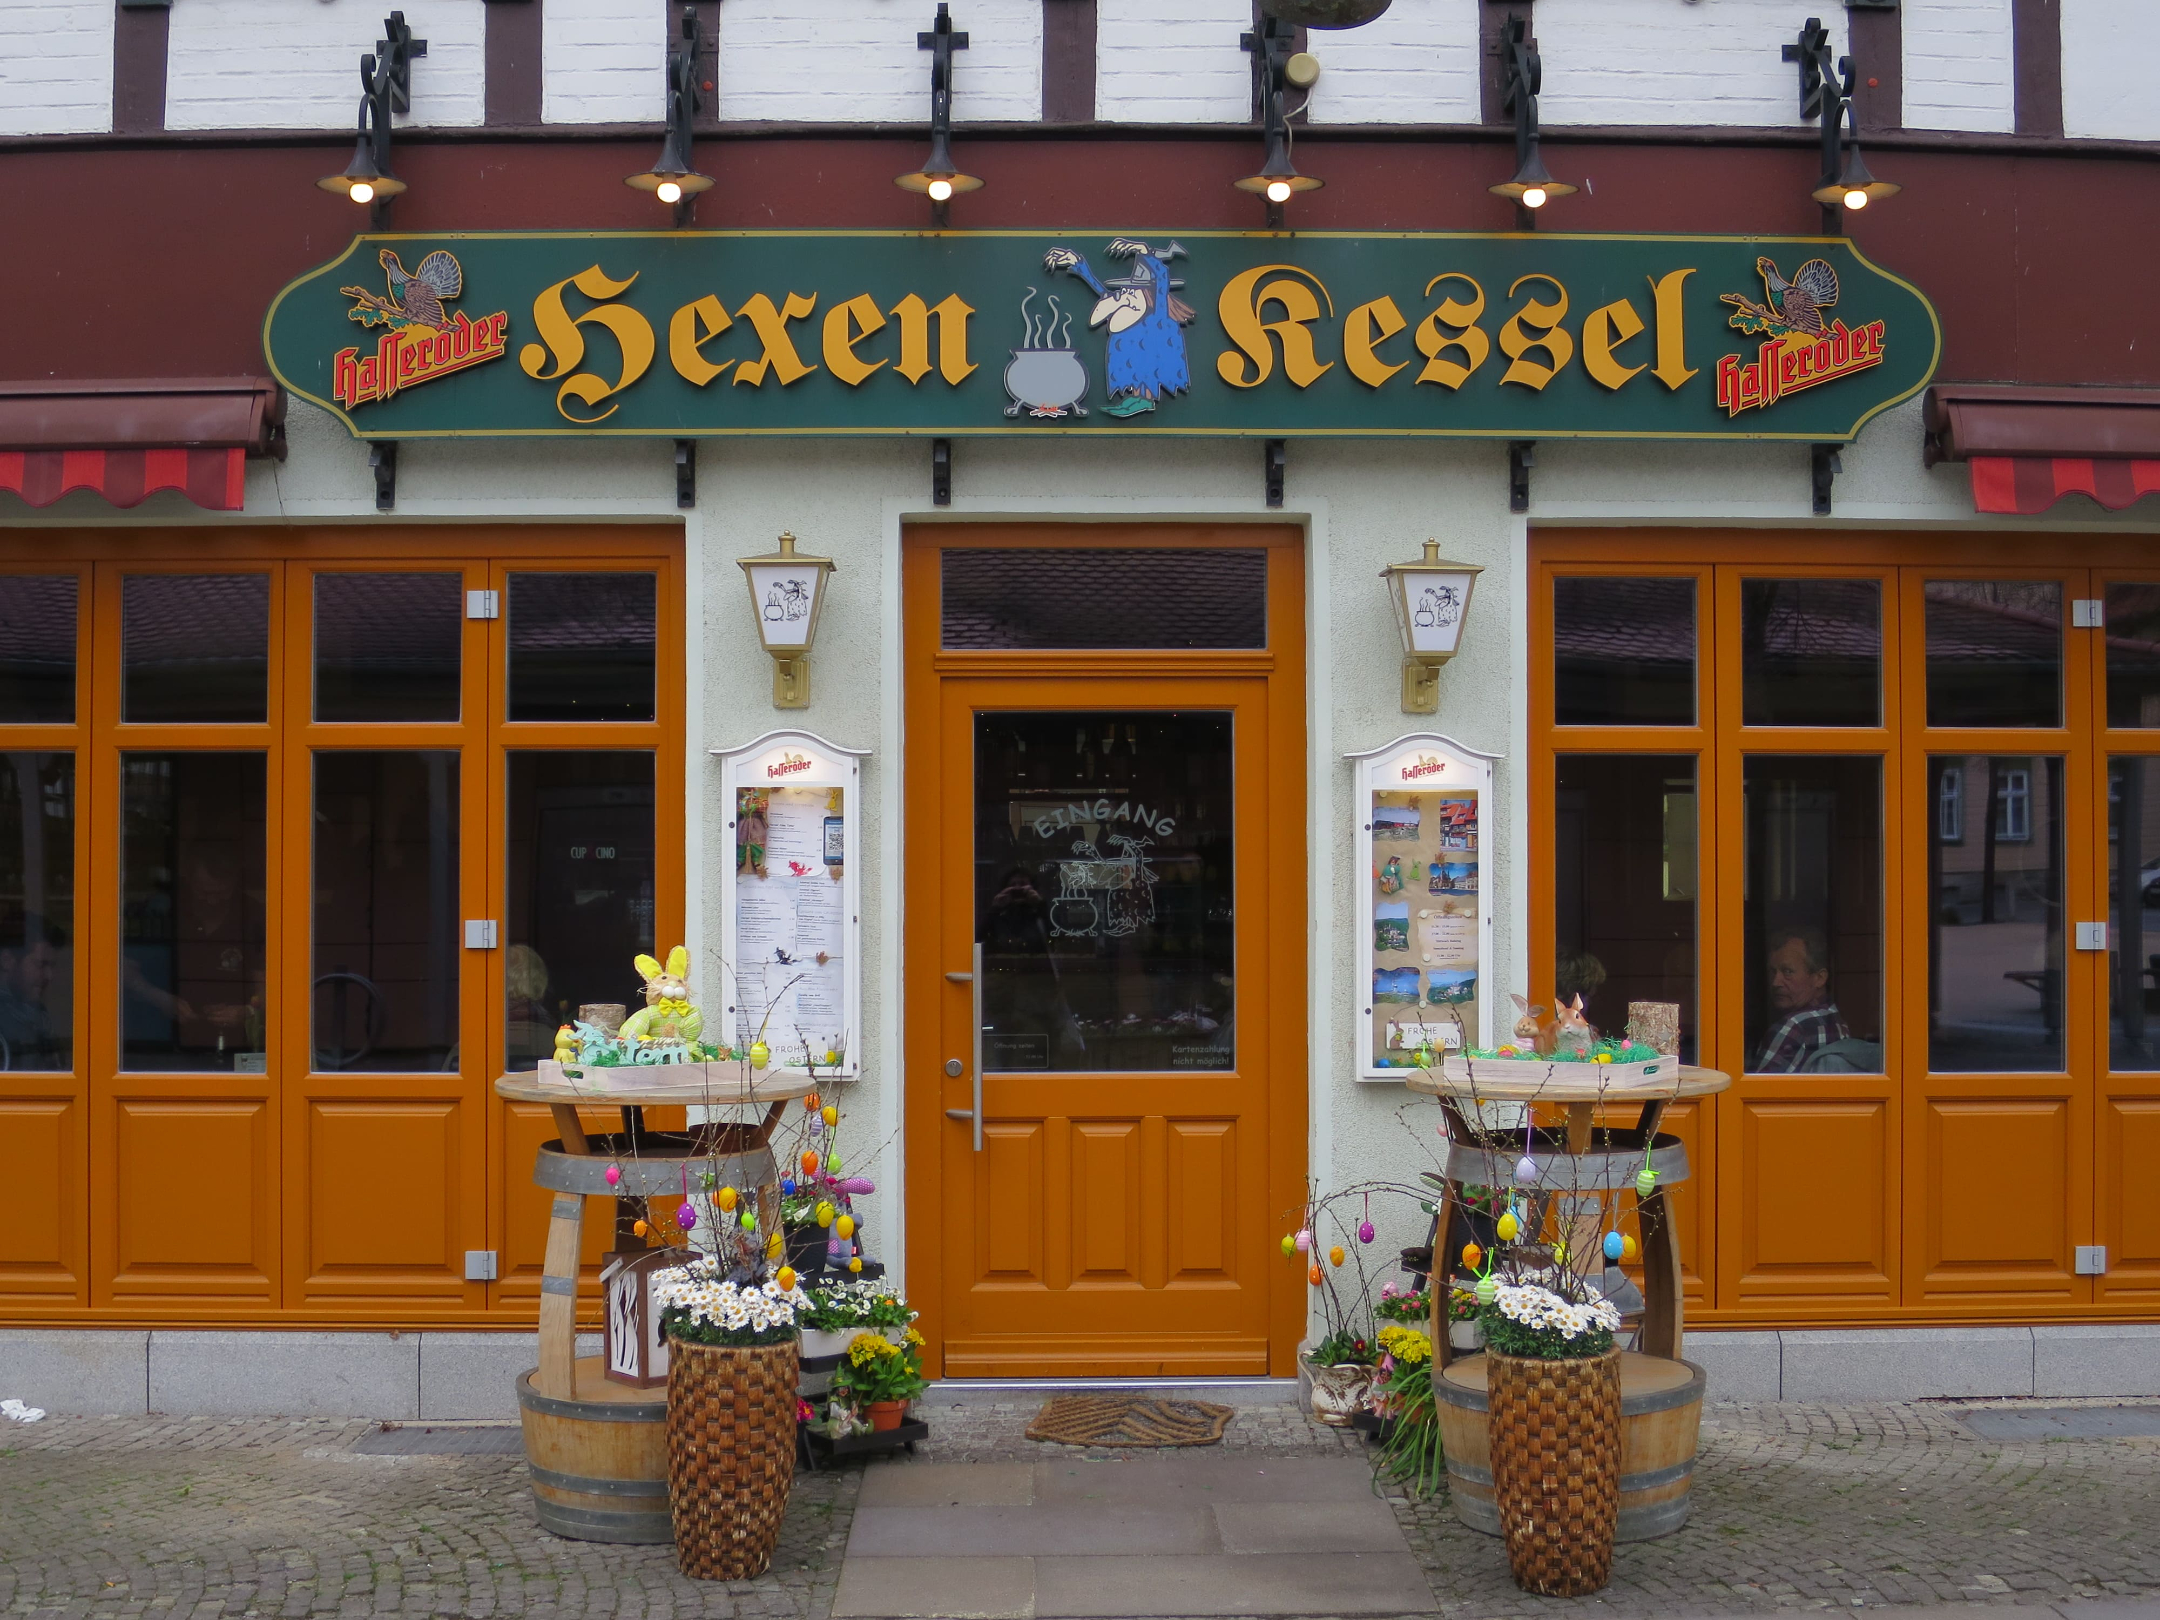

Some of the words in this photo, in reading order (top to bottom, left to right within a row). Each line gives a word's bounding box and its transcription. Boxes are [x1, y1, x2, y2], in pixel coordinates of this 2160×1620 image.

[519, 264, 979, 424] Hexen
[1216, 264, 1699, 391] Kessel
[1033, 798, 1176, 839] EINGANG
[1172, 1045, 1230, 1055] Kartenzahlung
[1173, 1057, 1193, 1065] nicht
[1197, 1057, 1229, 1066] möglich!
